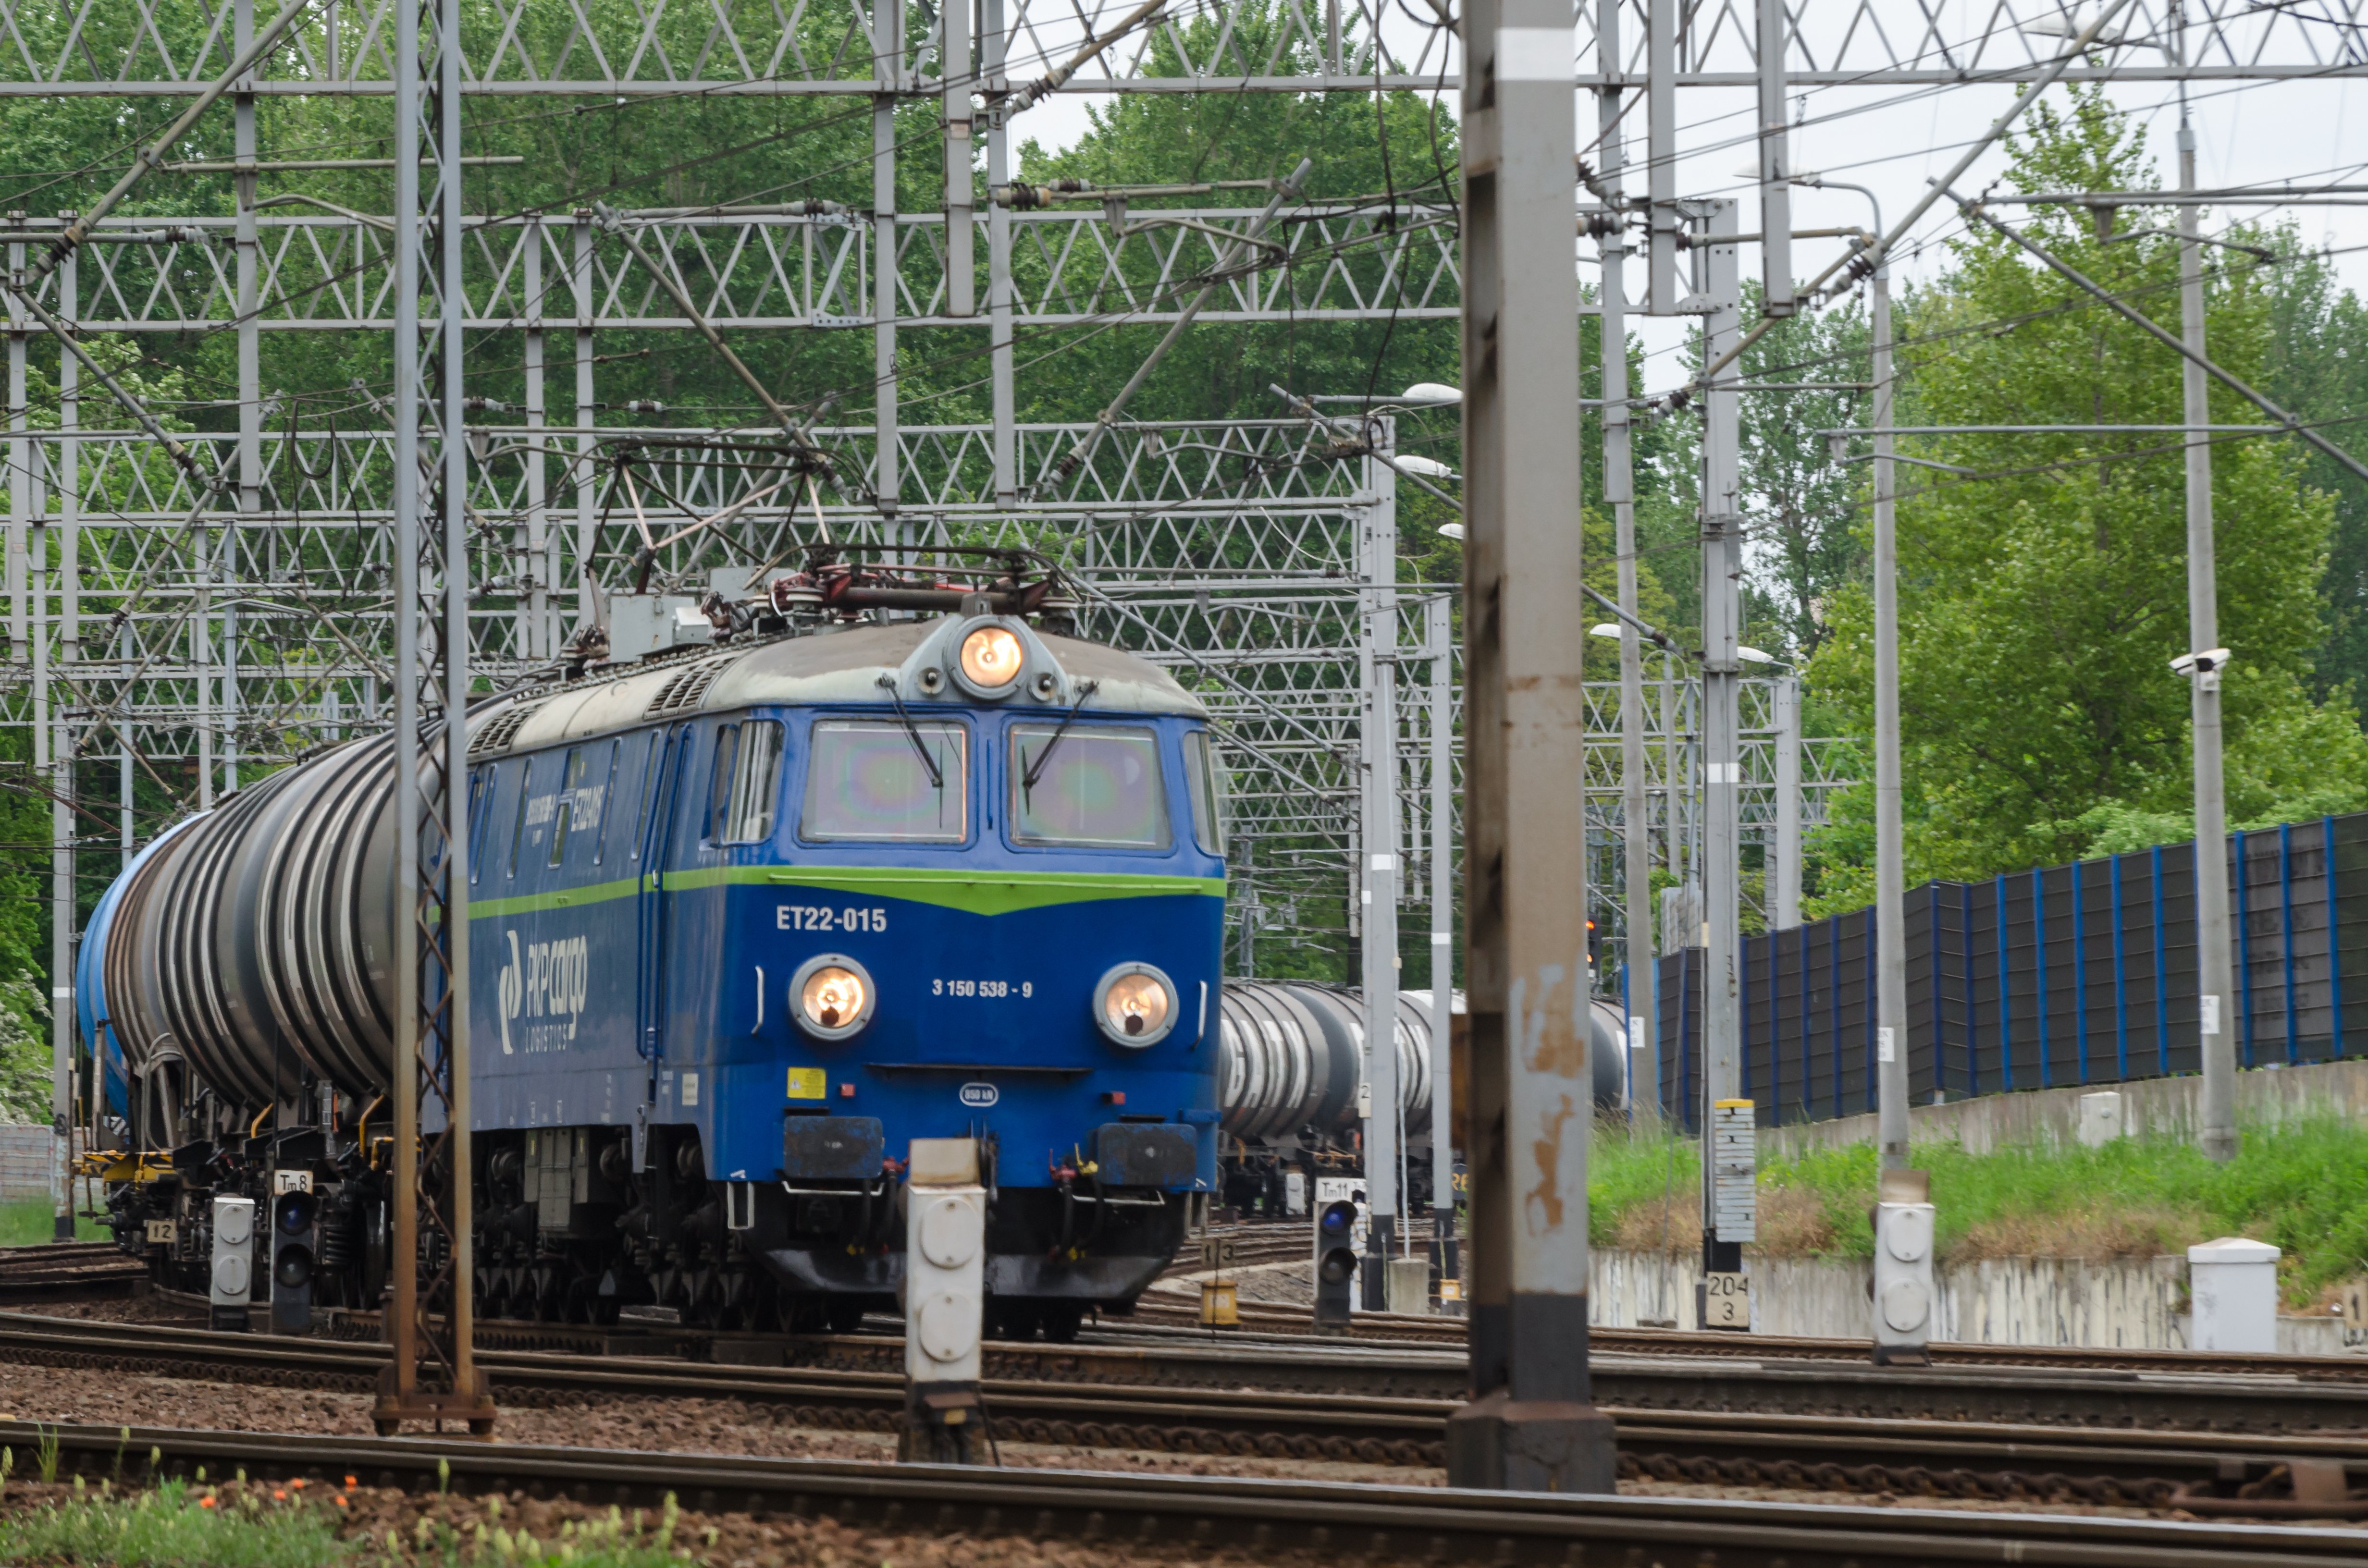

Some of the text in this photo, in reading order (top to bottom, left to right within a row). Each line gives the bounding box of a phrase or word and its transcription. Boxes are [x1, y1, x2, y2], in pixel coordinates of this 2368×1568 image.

[777, 906, 887, 932] ET22-015
[932, 979, 942, 995] 3
[947, 980, 975, 997] 150
[979, 980, 1007, 997] 538
[1022, 981, 1033, 998] 9
[526, 1023, 567, 1053] LOGISTICS
[1361, 1084, 1370, 1099] 2
[153, 1225, 172, 1239] 12
[1708, 1275, 1749, 1298] 204
[1722, 1301, 1734, 1321] 3
